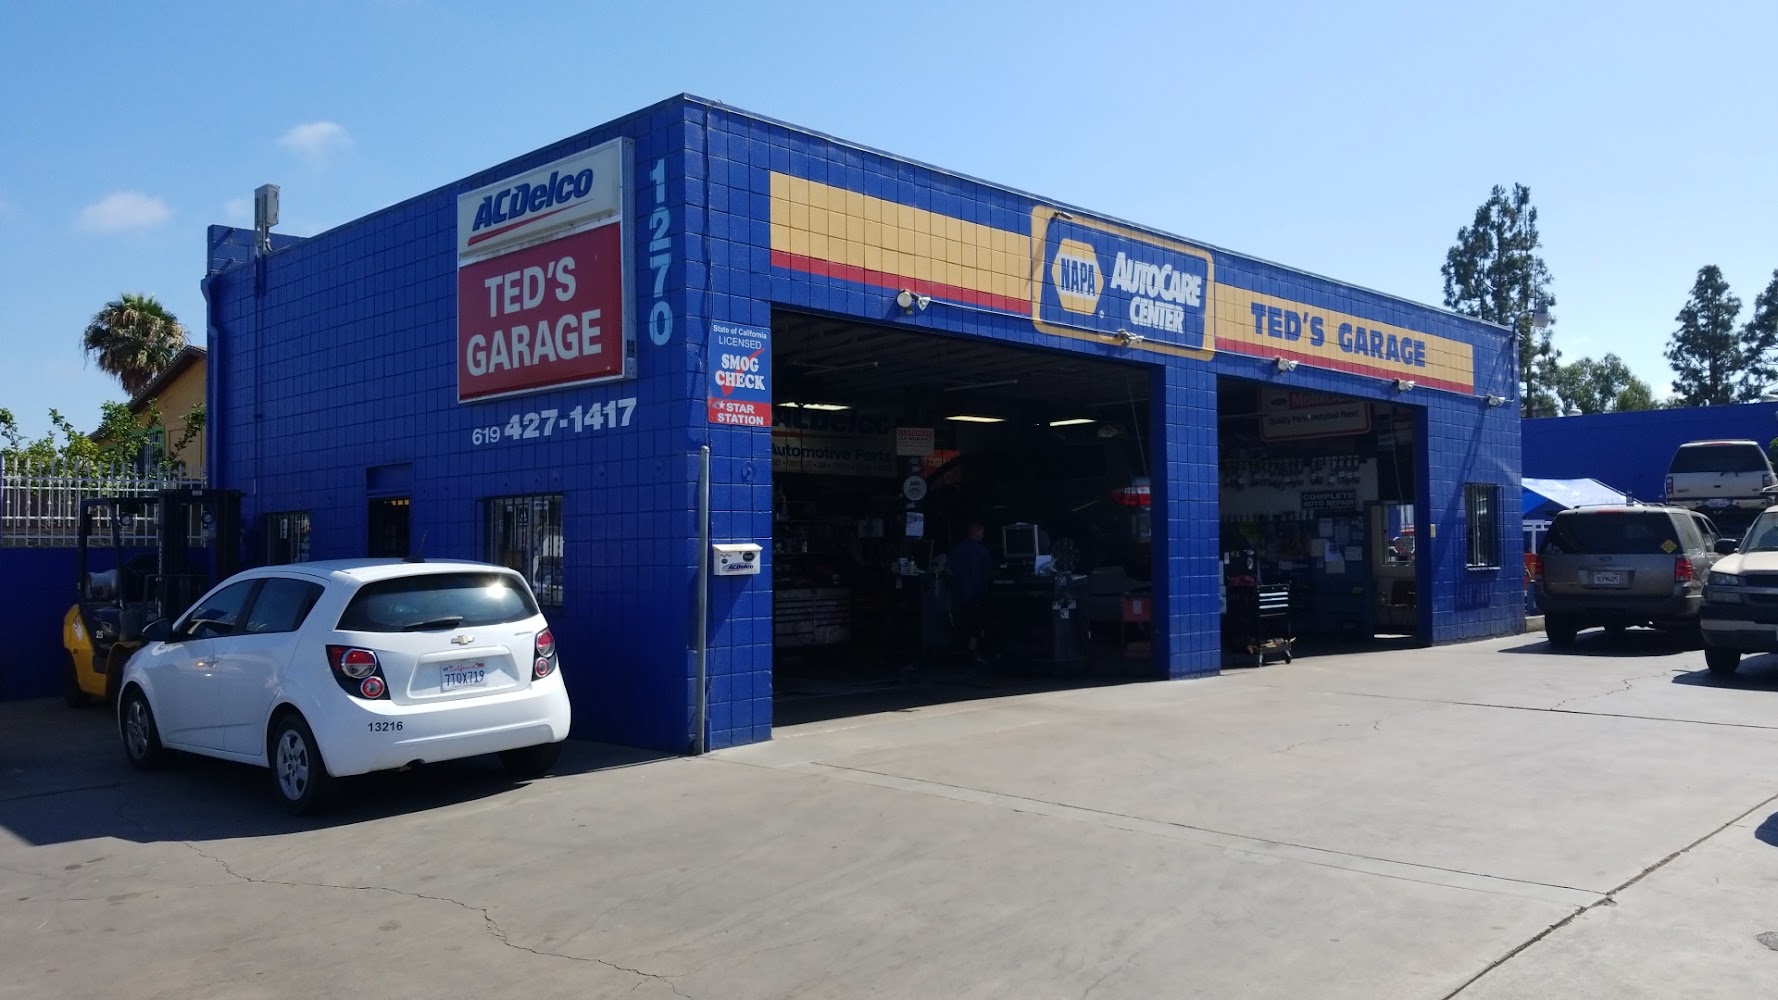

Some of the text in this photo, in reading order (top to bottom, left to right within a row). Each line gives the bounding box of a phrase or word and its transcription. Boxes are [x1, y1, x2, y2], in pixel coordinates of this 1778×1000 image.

[472, 168, 593, 232] ACDelco
[650, 158, 673, 346] 1270
[484, 256, 577, 318] TED'S
[1060, 257, 1096, 297] NAPA
[1129, 296, 1184, 334] CENTER
[713, 324, 729, 334] State
[738, 327, 767, 340] California
[1250, 302, 1426, 368] TED'S GARAGE
[466, 309, 602, 377] GARAGE
[718, 336, 762, 350] LICENSED
[721, 353, 759, 373] SMOG
[715, 370, 765, 390] CHECK
[726, 402, 755, 414] STAR
[472, 397, 637, 446] 619 427-1417
[717, 412, 764, 426] STATION
[771, 444, 849, 460] Automotive
[1303, 492, 1354, 501] COMPLETE
[95, 630, 104, 639] 25
[367, 721, 403, 732] 13216
